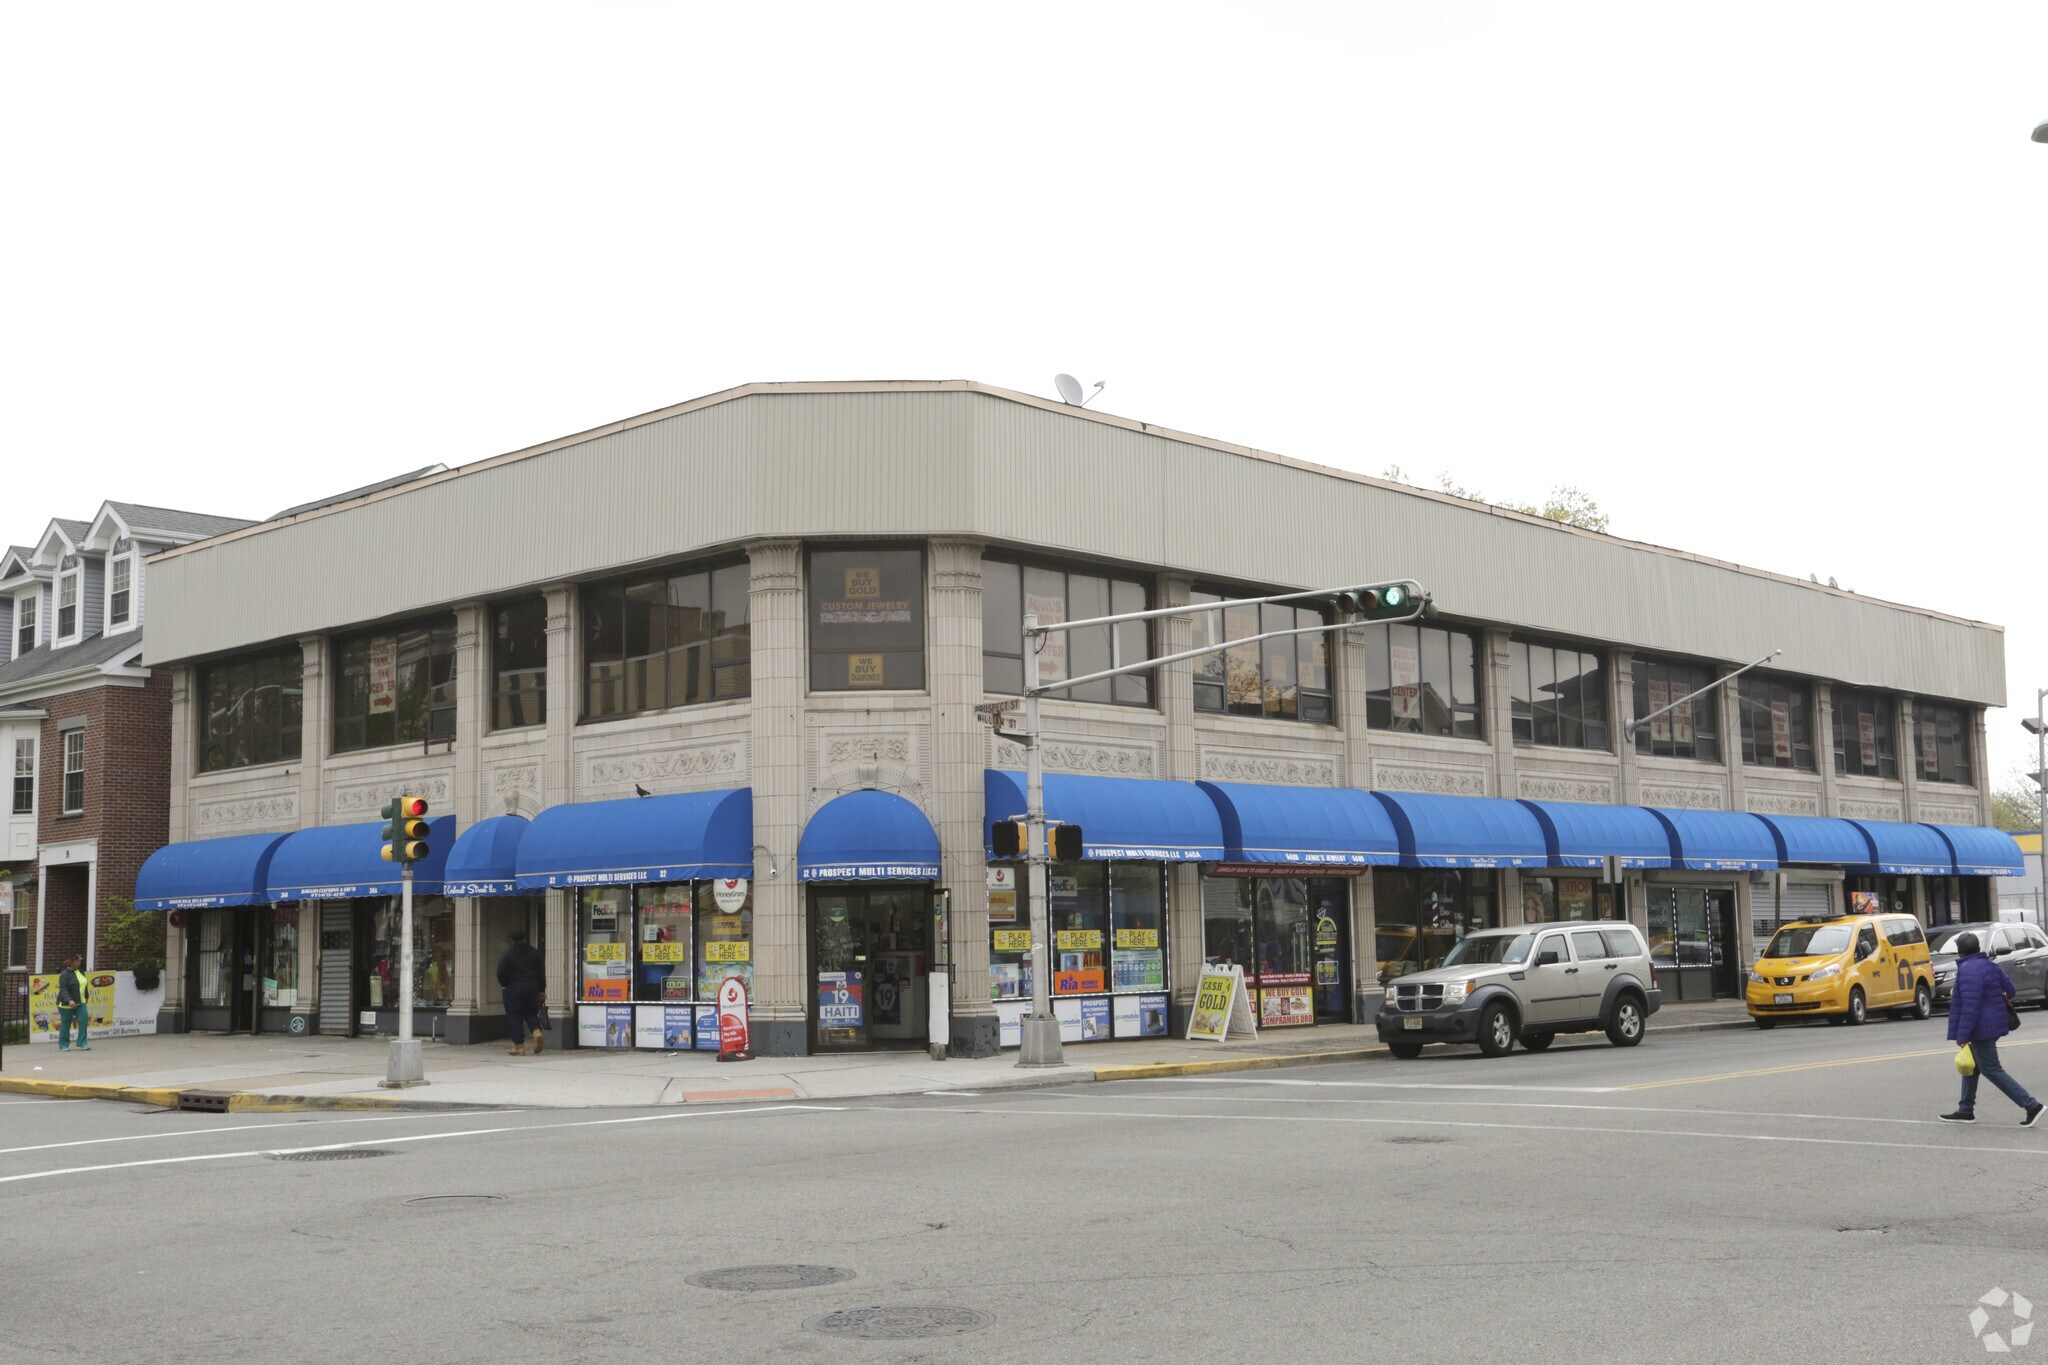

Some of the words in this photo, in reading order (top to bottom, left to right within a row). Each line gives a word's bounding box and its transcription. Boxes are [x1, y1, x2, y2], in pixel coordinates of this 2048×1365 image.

[822, 602, 864, 610] CUSTOM
[866, 602, 908, 610] JEWELRY
[852, 674, 880, 682] DIAMONDS
[1392, 686, 1418, 698] CENTER
[975, 702, 1008, 714] PROSPECT
[1010, 700, 1018, 710] ST
[1009, 719, 1016, 728] ST
[1144, 850, 1170, 858] SERVICES
[573, 874, 597, 882] PROSPECT
[598, 874, 613, 882] MULTI
[614, 872, 637, 880] SERVICES
[638, 871, 647, 880] LLC
[660, 870, 667, 878] 32
[819, 868, 856, 877] PROSPECT
[858, 868, 884, 876] MULTI
[887, 867, 921, 876] SERVICES
[1050, 880, 1075, 892] FedEx
[593, 904, 614, 916] FedEx
[1008, 940, 1026, 948] HERE
[1129, 938, 1146, 946] HERE
[599, 952, 614, 960] HERE
[1084, 952, 1102, 967] ATM
[1060, 975, 1078, 990] Ria
[1226, 982, 1230, 991] 4
[588, 983, 604, 998] Ria
[1266, 988, 1275, 997] WE
[1277, 988, 1290, 996] BUY
[1291, 987, 1306, 996] GOLD
[832, 989, 849, 1004] 19
[1200, 994, 1226, 1010] GOLD
[825, 1007, 858, 1017] HAITI
[1262, 1016, 1300, 1025] COMPRAMOS
[1301, 1015, 1312, 1023] ORO
